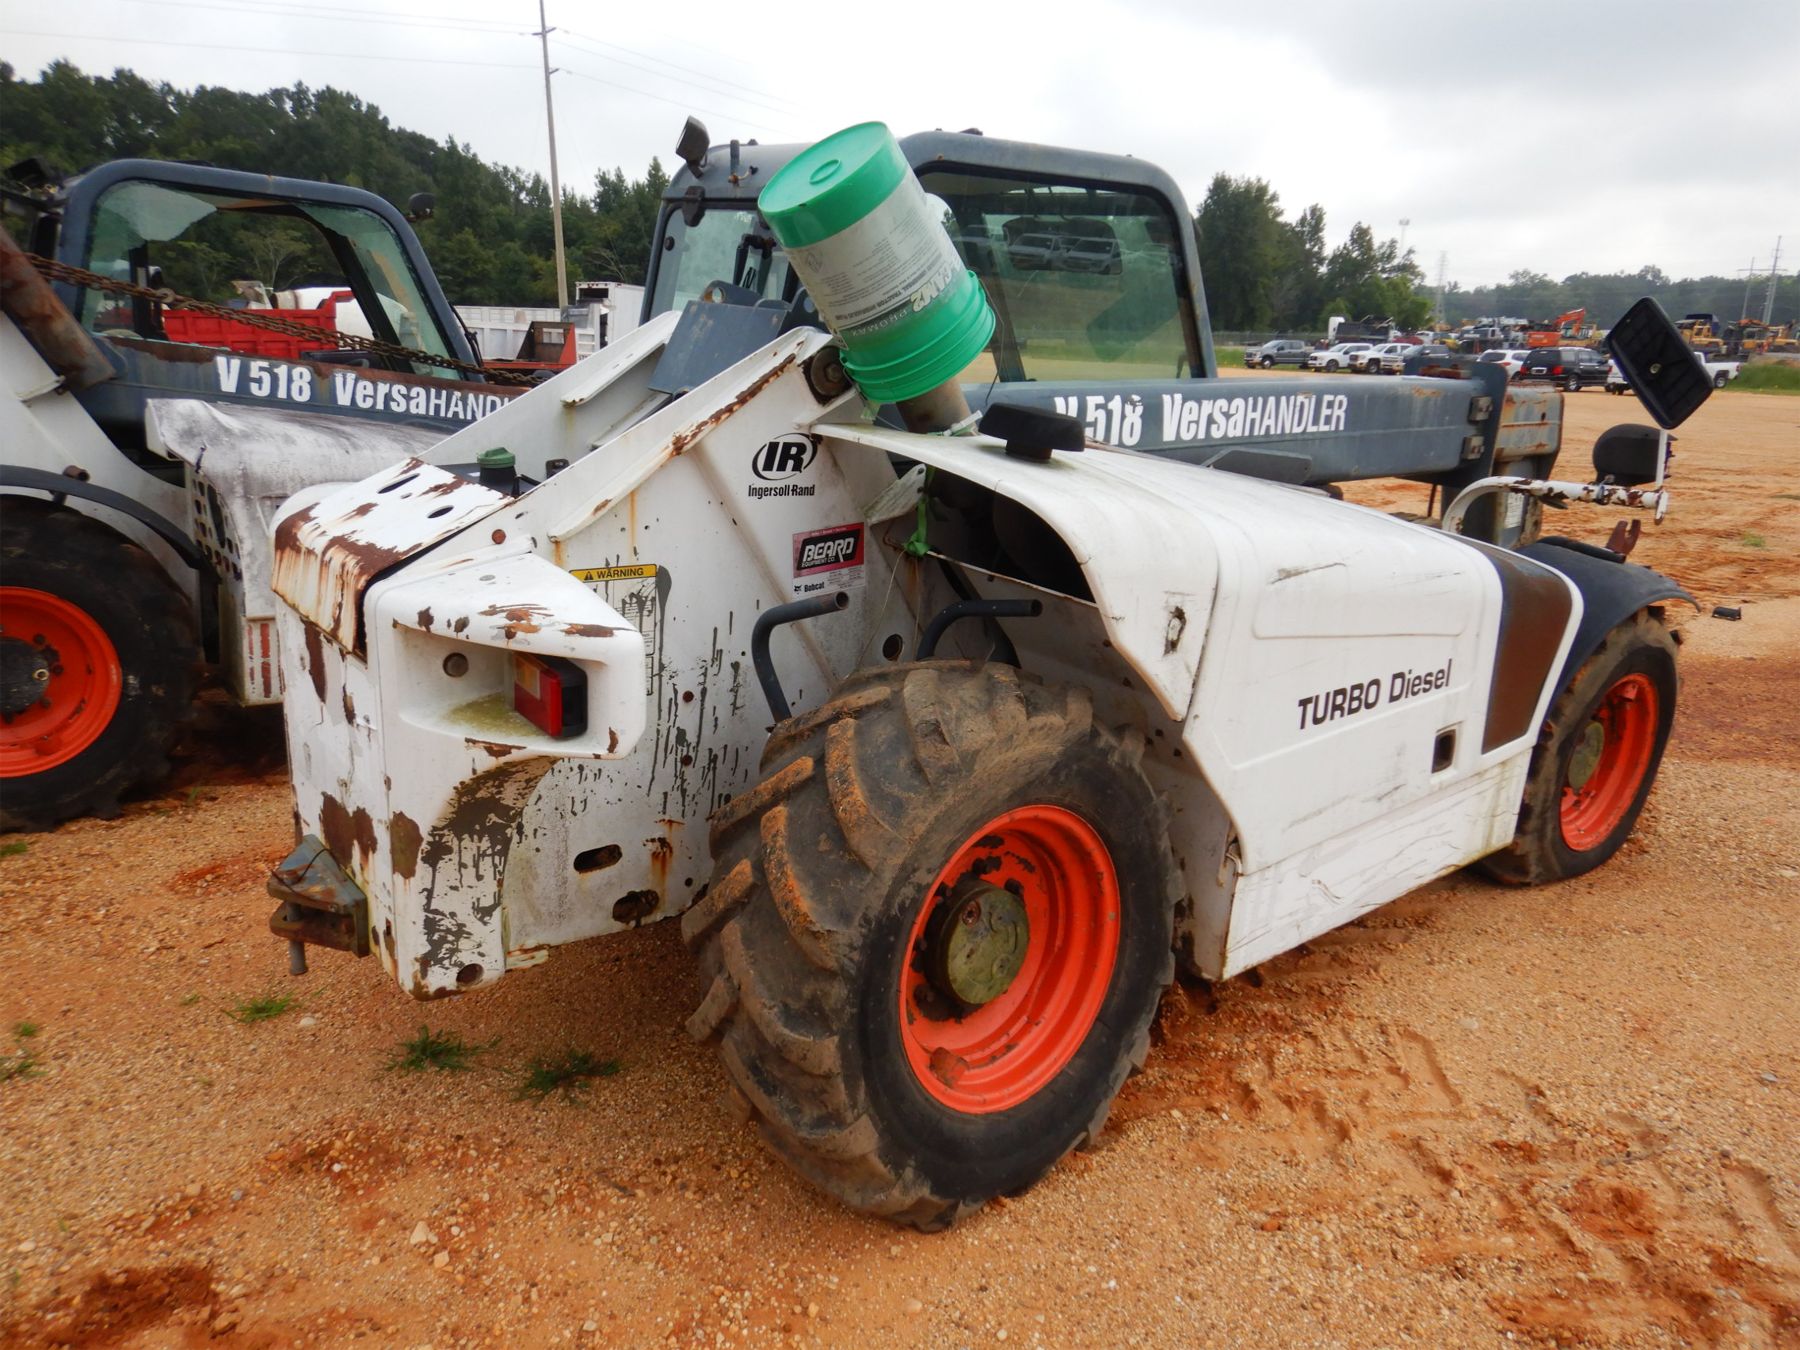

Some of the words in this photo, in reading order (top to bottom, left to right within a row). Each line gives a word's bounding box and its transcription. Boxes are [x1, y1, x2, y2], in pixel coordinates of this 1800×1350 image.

[852, 309, 908, 337] PROMAX
[215, 355, 241, 393] V
[249, 361, 312, 402] 518
[334, 371, 511, 421] VersaHAND
[1084, 394, 1144, 447] 518
[1161, 393, 1348, 442] VersaHANDLER
[762, 441, 807, 473] IR
[803, 537, 855, 562] BEARD
[596, 567, 645, 580] WARNING
[804, 582, 825, 593] Bobcat
[1298, 678, 1382, 730] TURBO
[1388, 658, 1453, 704] Diesel
